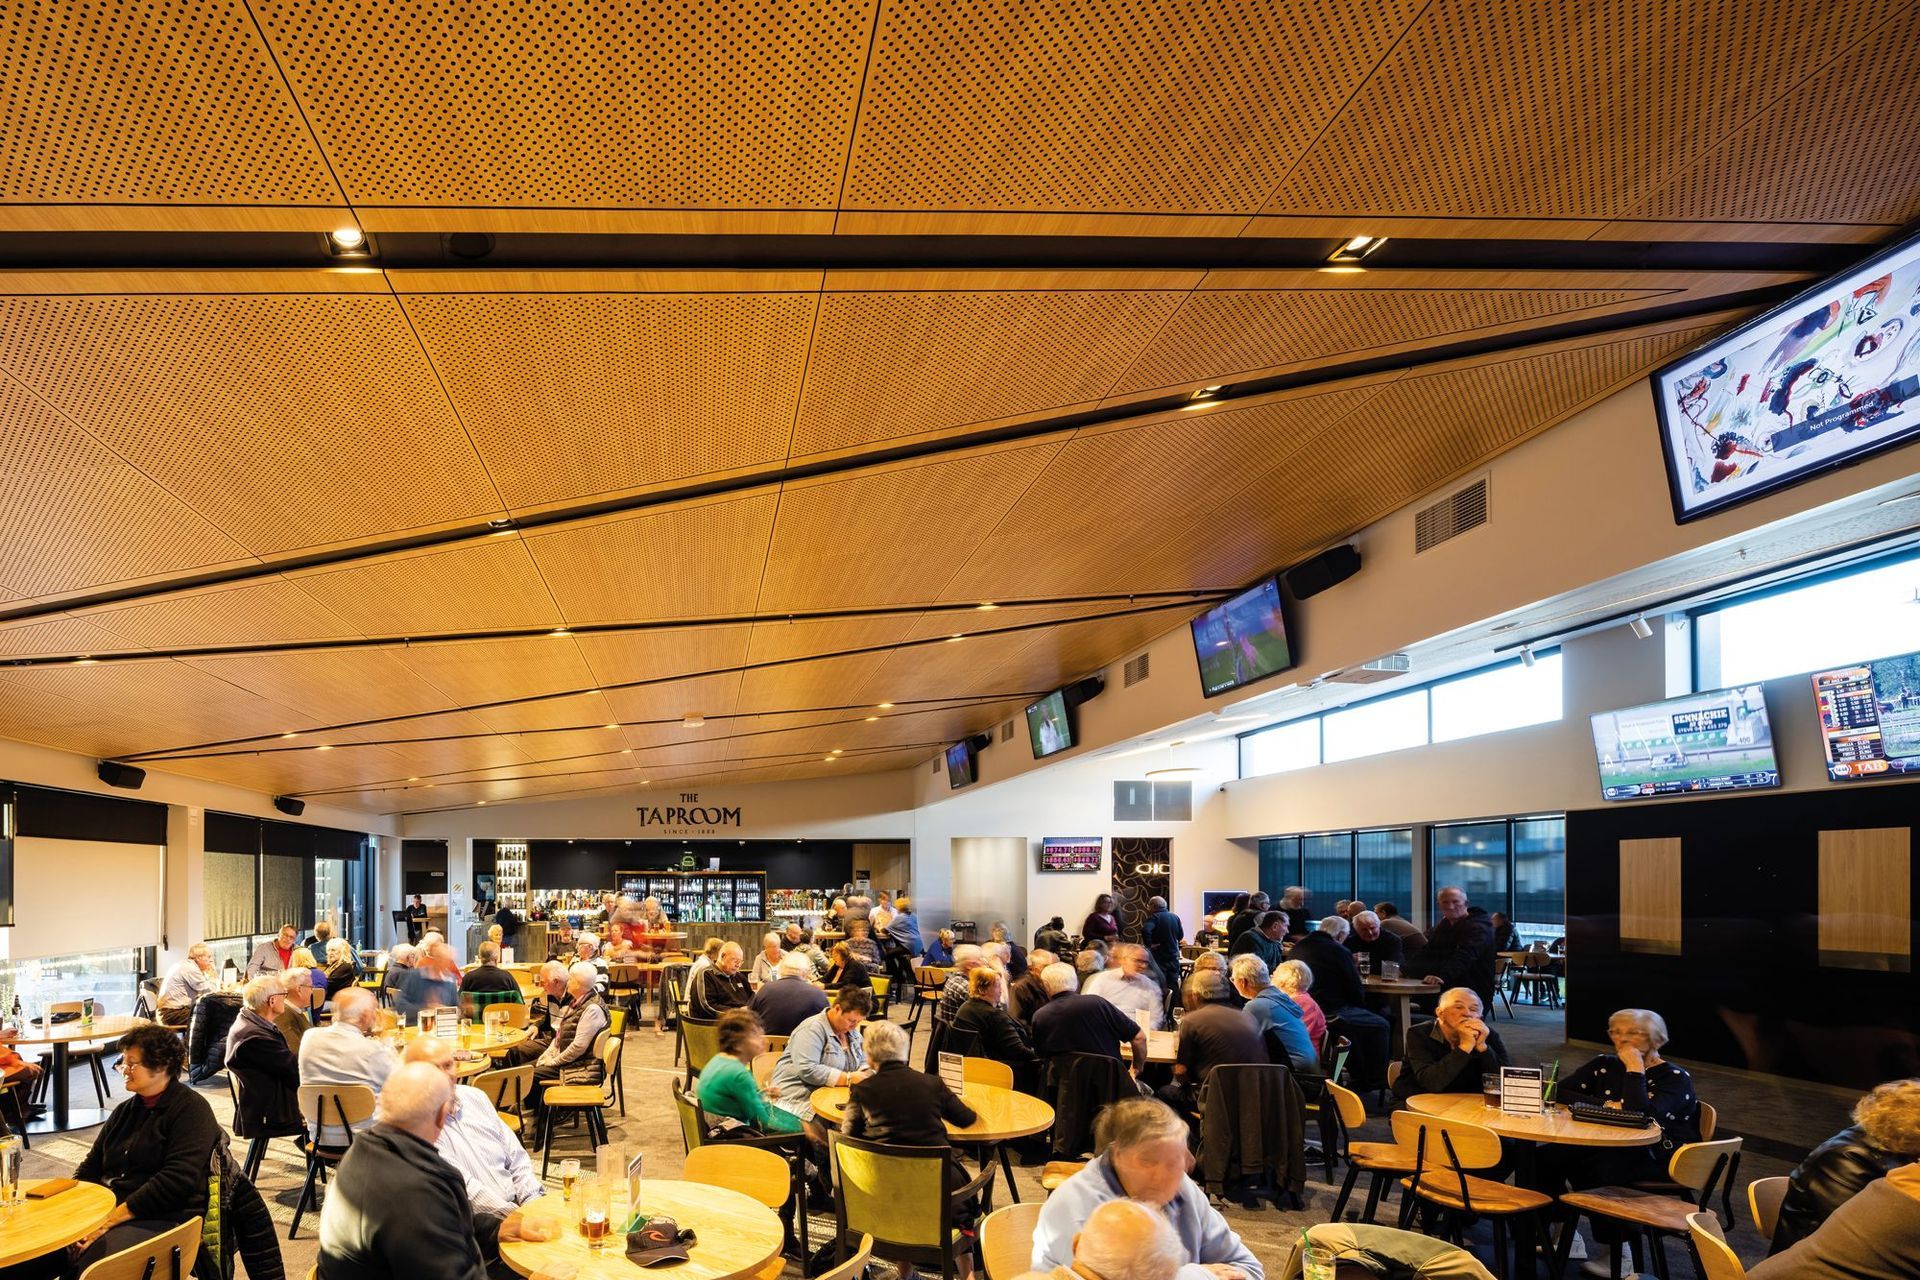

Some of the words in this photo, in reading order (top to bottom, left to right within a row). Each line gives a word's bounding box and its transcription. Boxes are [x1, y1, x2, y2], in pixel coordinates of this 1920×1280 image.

[1809, 421, 1824, 432] Not
[1825, 401, 1874, 425] Programmed
[1674, 709, 1728, 723] SENNACHIE
[680, 793, 699, 803] THE
[637, 807, 741, 827] TAPROOM
